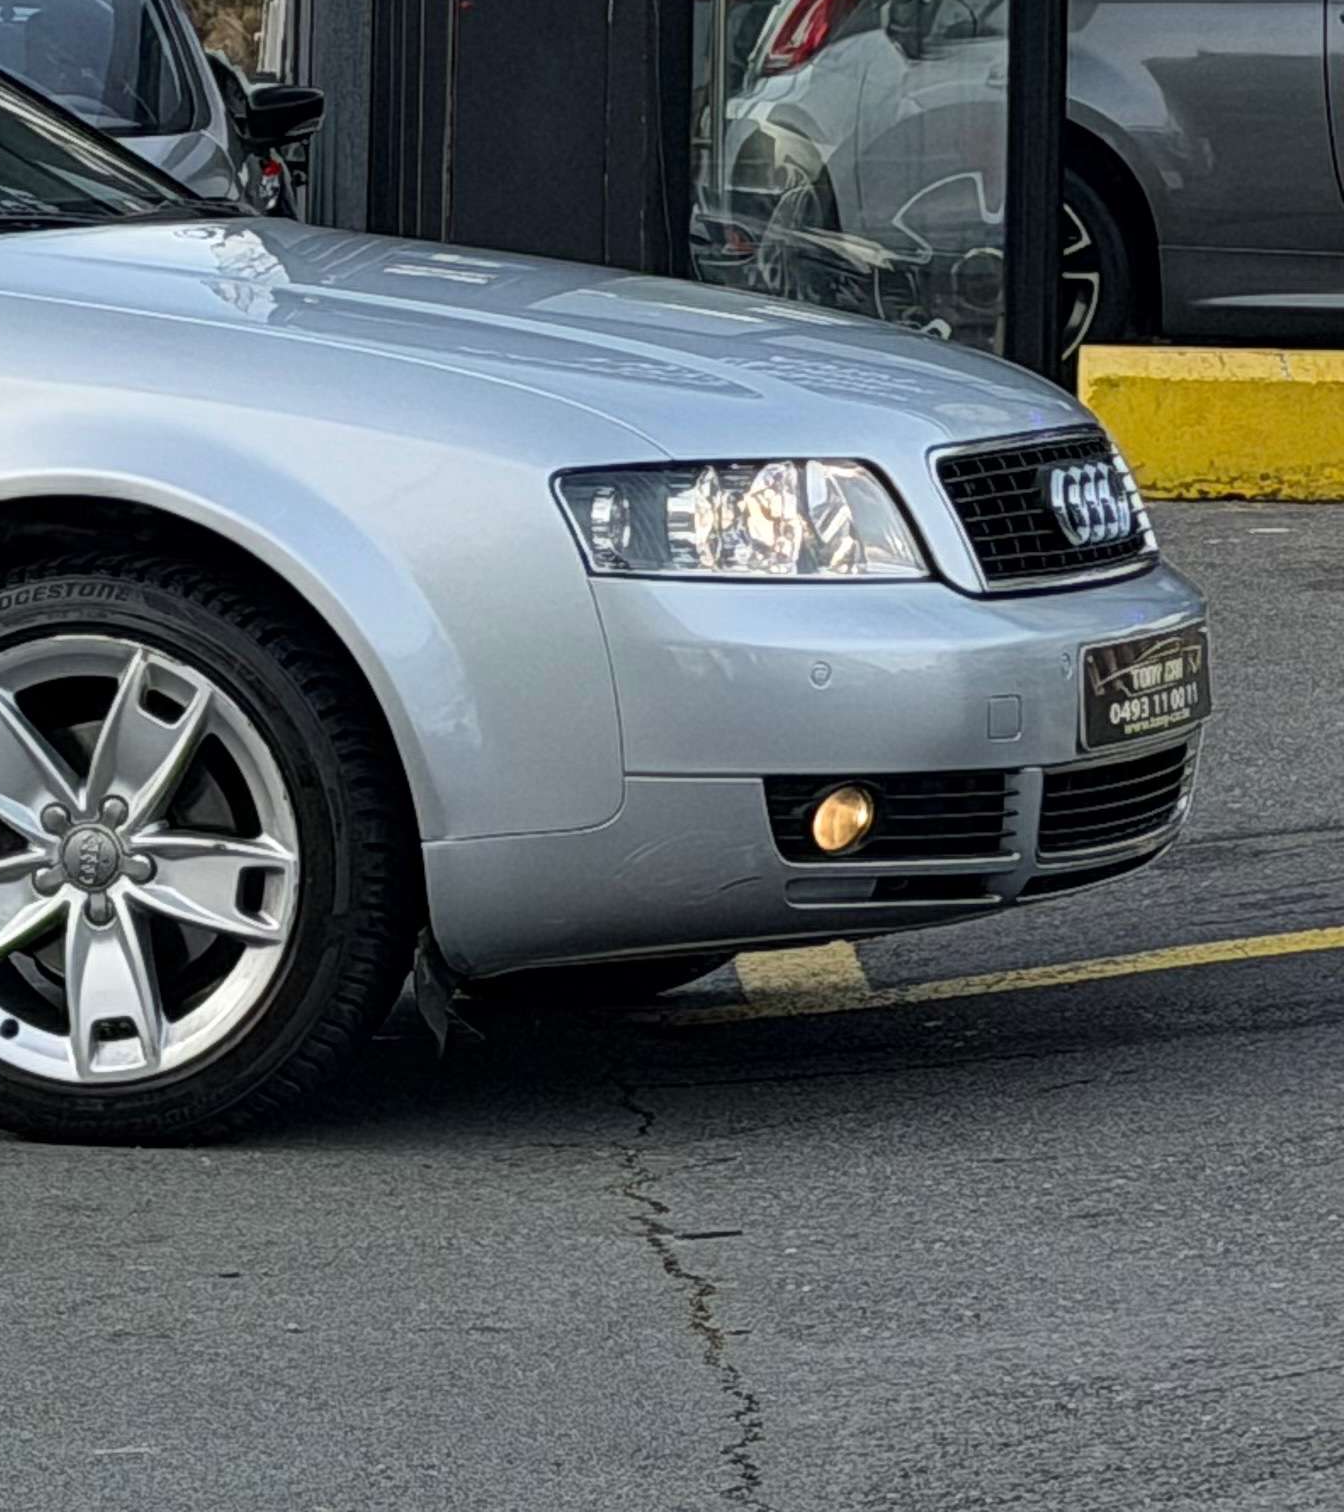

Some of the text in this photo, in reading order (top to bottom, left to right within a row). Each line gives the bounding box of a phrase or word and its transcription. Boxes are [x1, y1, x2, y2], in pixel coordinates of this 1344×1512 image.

[1109, 694, 1150, 725] 0493
[1152, 690, 1169, 715] 11
[1185, 681, 1198, 705] 11
